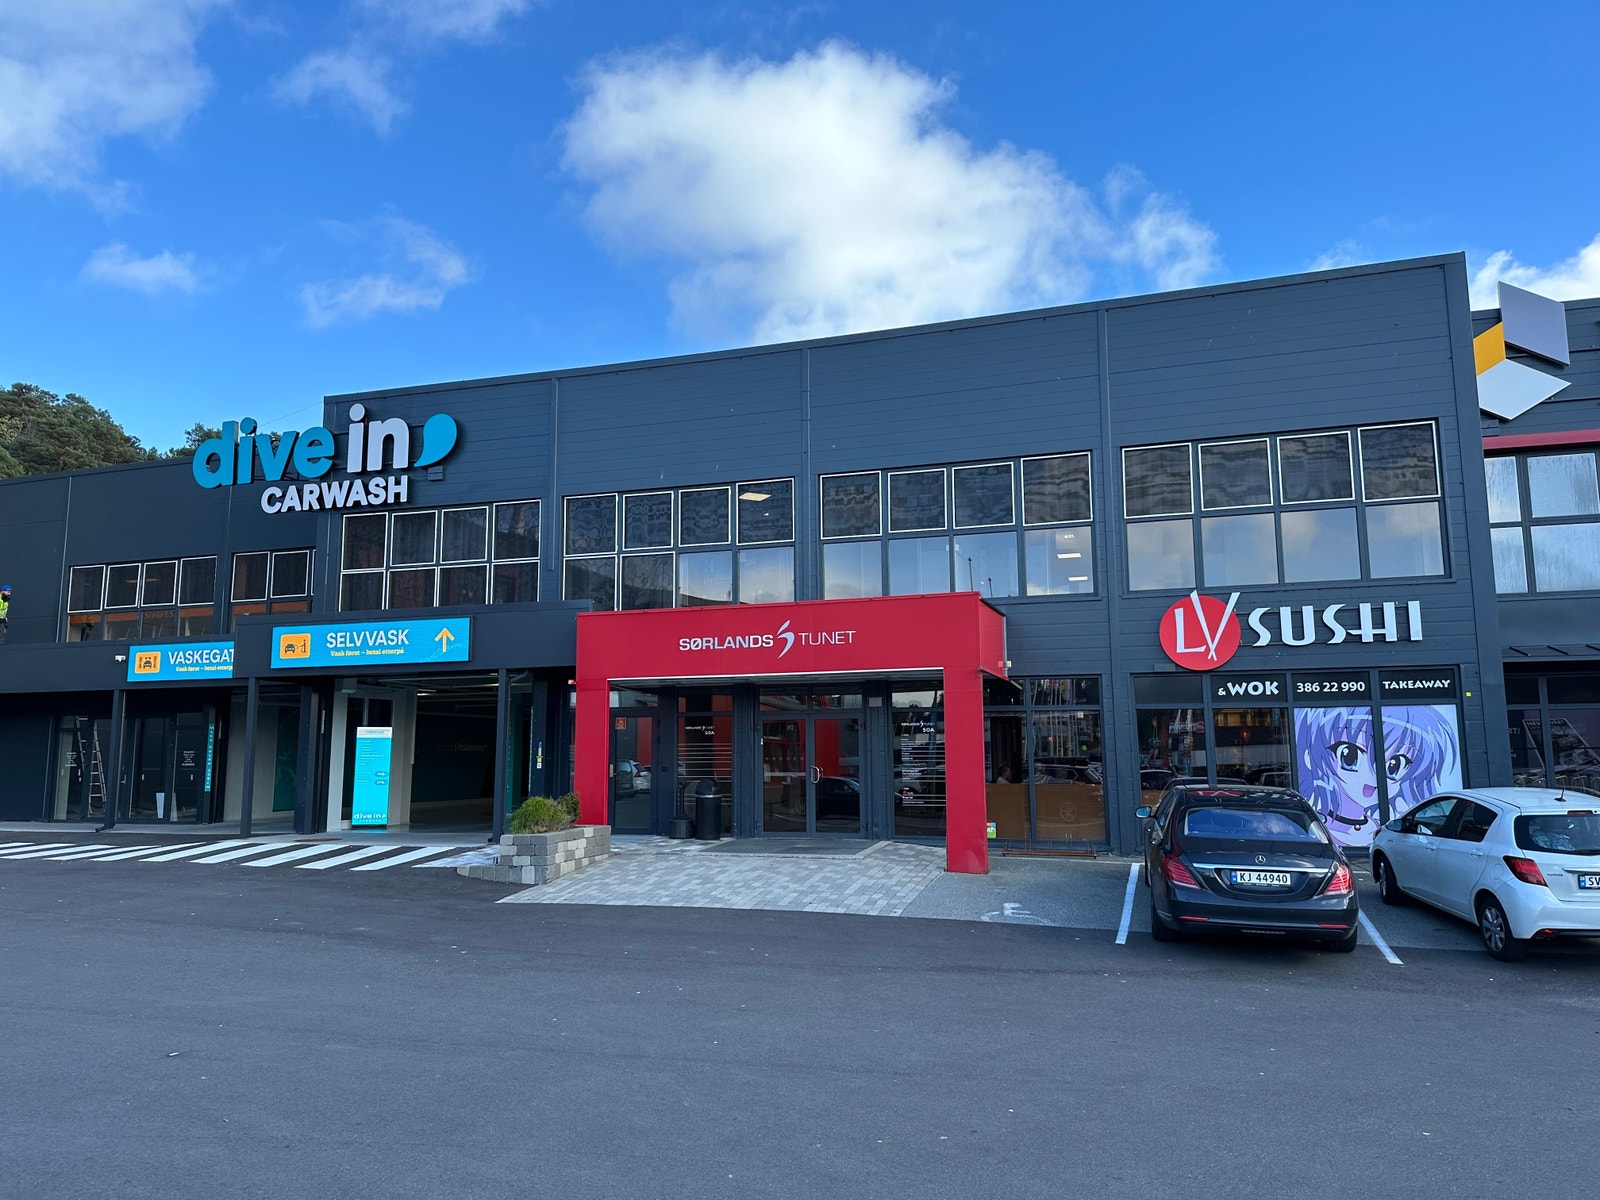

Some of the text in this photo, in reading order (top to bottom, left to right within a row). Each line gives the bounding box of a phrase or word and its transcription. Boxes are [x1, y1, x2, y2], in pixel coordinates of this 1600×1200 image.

[192, 403, 409, 489] dive in
[261, 475, 408, 514] CARWASH
[1174, 589, 1423, 661] LV SUSHI
[326, 628, 409, 648] SELVVASK
[679, 630, 856, 651] SØRLANDS TUNET
[1296, 681, 1366, 693] 386 22 990
[1382, 678, 1451, 690] TAKEAWAY
[1239, 872, 1288, 884] KJ 44940
